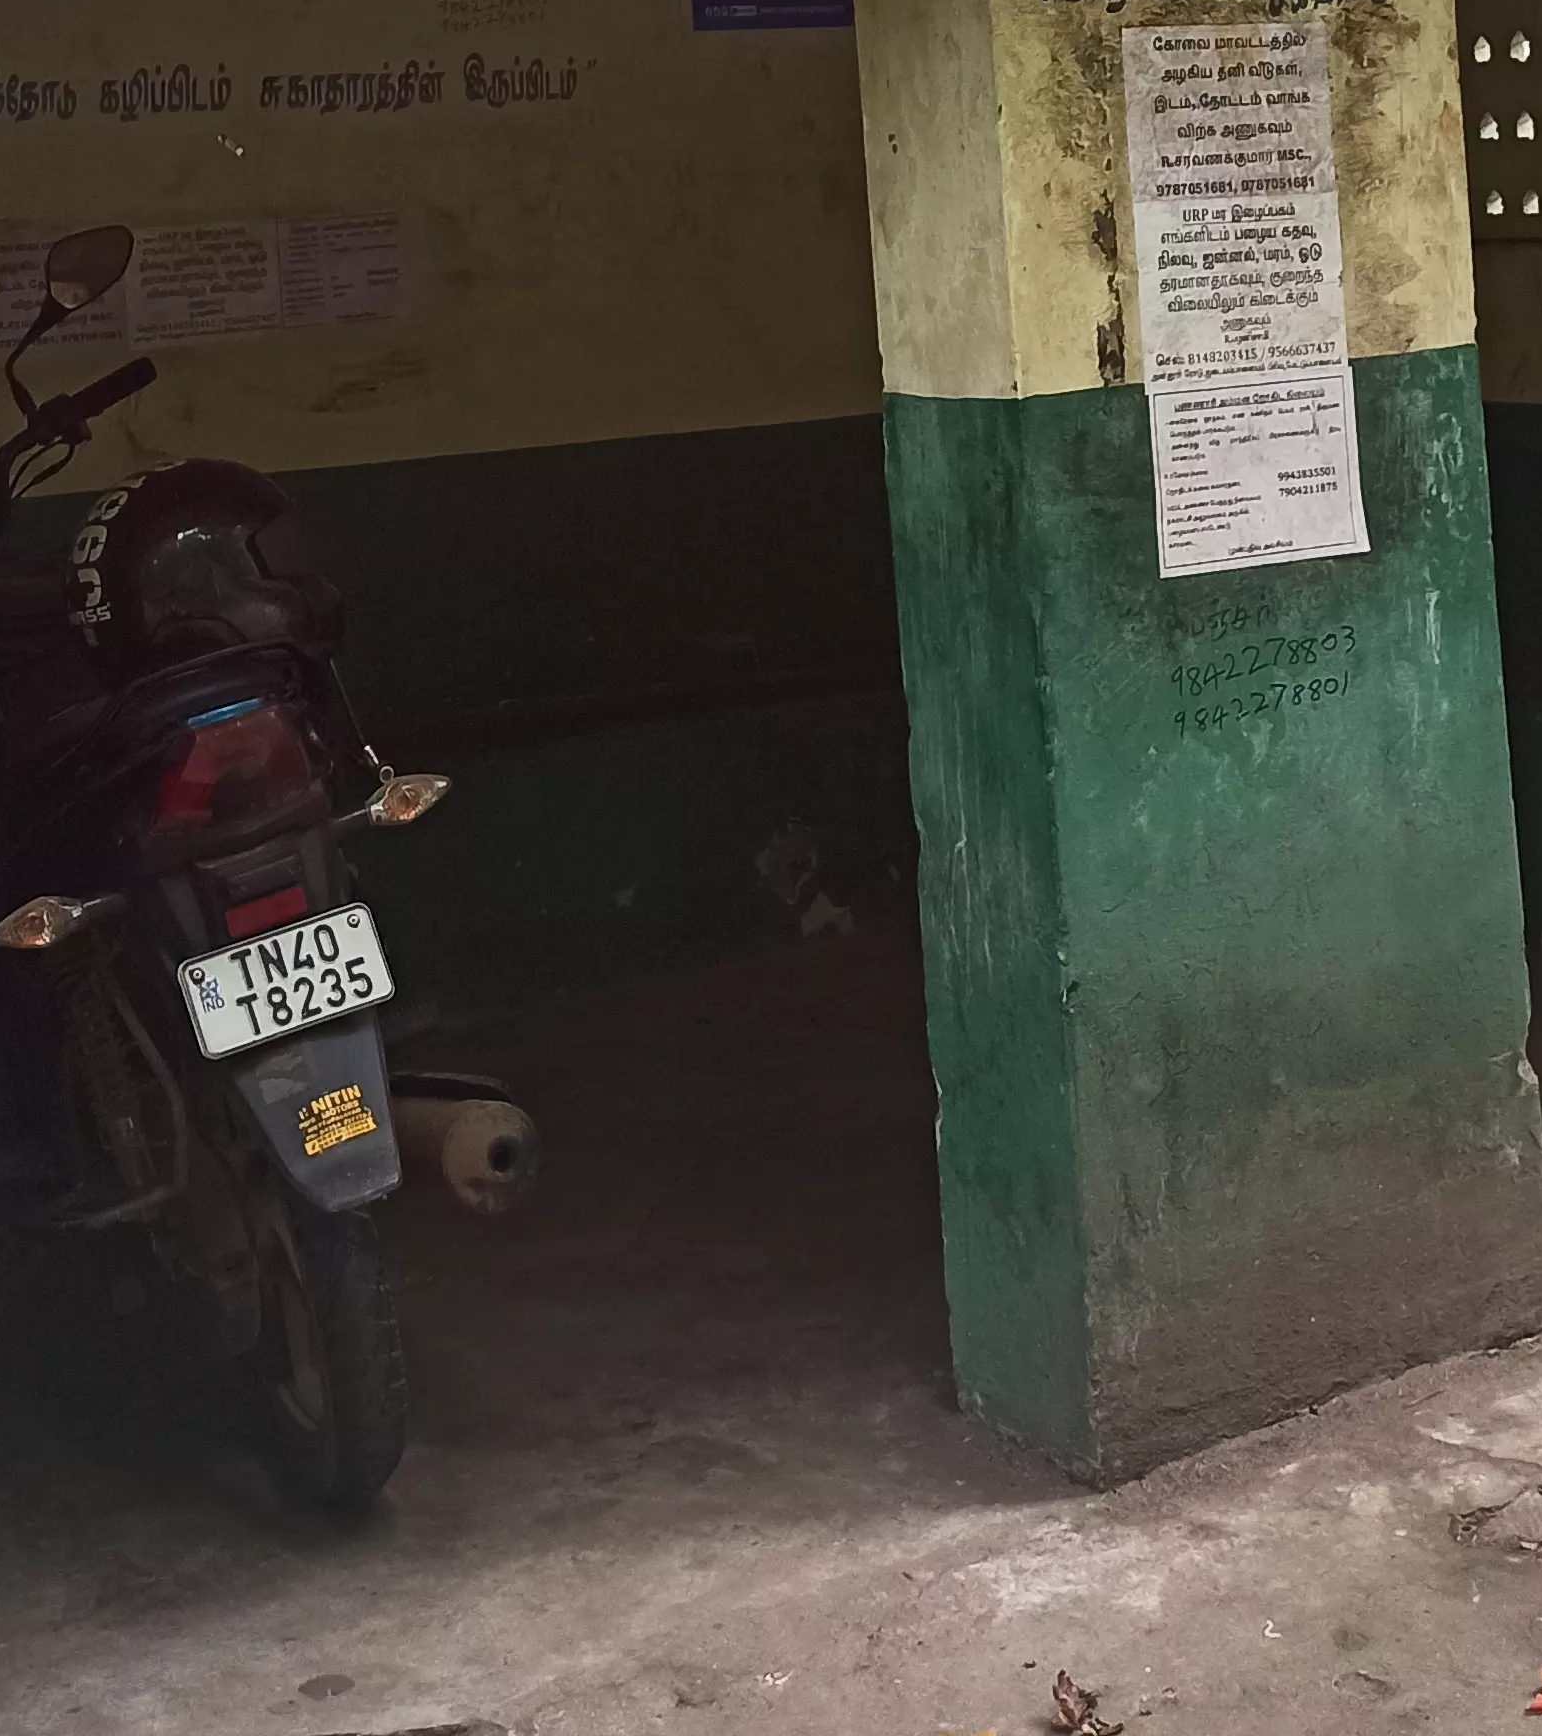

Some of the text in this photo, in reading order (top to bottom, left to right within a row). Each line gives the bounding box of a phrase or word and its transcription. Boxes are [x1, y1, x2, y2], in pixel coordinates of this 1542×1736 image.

[1153, 36, 1210, 53] கோவை
[1161, 66, 1213, 83] அழகிய
[1217, 63, 1246, 81] தனி
[1266, 90, 1311, 107] வாங்க
[1220, 119, 1293, 140] அணுகவும்
[1182, 207, 1209, 223] URP
[1234, 225, 1277, 243] பழைய
[1171, 625, 1356, 698] 9842278803
[1174, 671, 1350, 739] 9842278801
[229, 922, 341, 990] TN40
[236, 955, 374, 1038] T8235
[310, 1083, 362, 1114] NITIN
